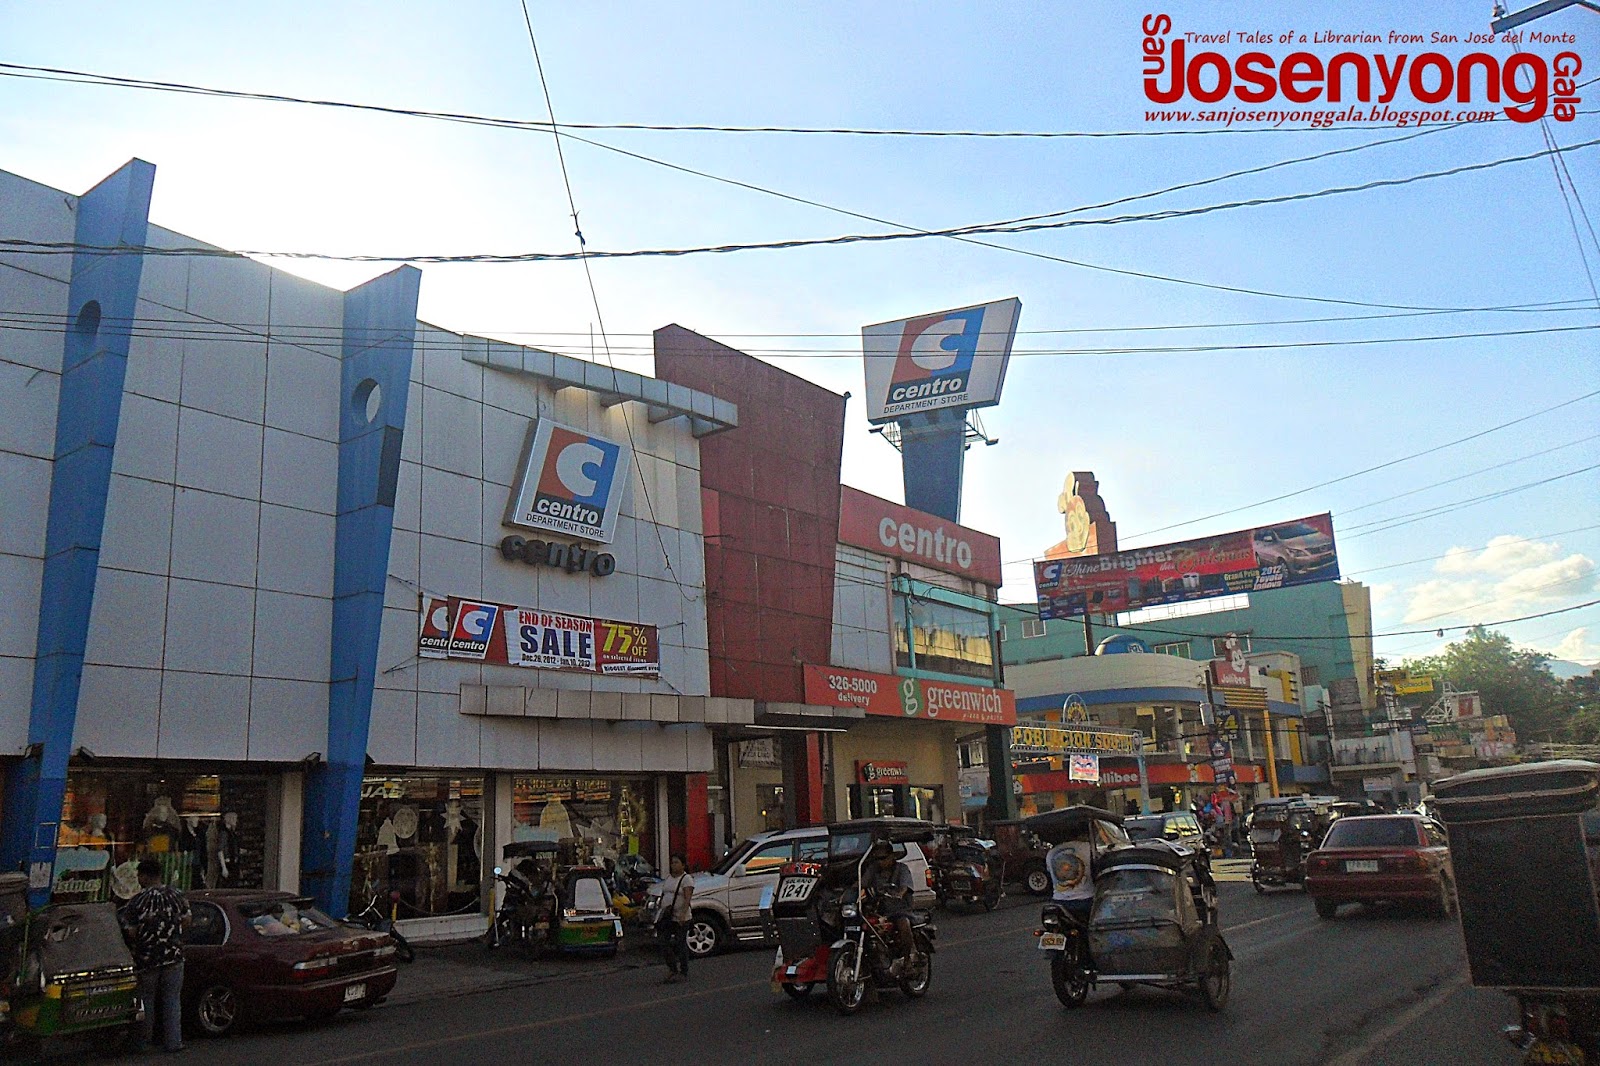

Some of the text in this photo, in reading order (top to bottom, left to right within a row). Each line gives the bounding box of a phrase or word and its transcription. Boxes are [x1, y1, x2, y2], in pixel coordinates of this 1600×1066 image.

[892, 377, 963, 401] centro
[884, 393, 969, 414] DEPARTMENT STORE
[536, 498, 599, 525] centro
[526, 513, 604, 538] DEPARTMENT STORE
[878, 517, 972, 569] centro
[518, 610, 592, 633] END OF SEASON
[452, 640, 485, 651] centro
[520, 624, 592, 659] SALE
[601, 622, 647, 654] 75 %
[631, 645, 648, 657] OFF
[829, 674, 878, 694] 326-5000
[838, 692, 870, 706] delivery
[926, 686, 1003, 717] greenwich
[1013, 727, 1090, 749] POBLACION
[781, 884, 811, 899] 1241
